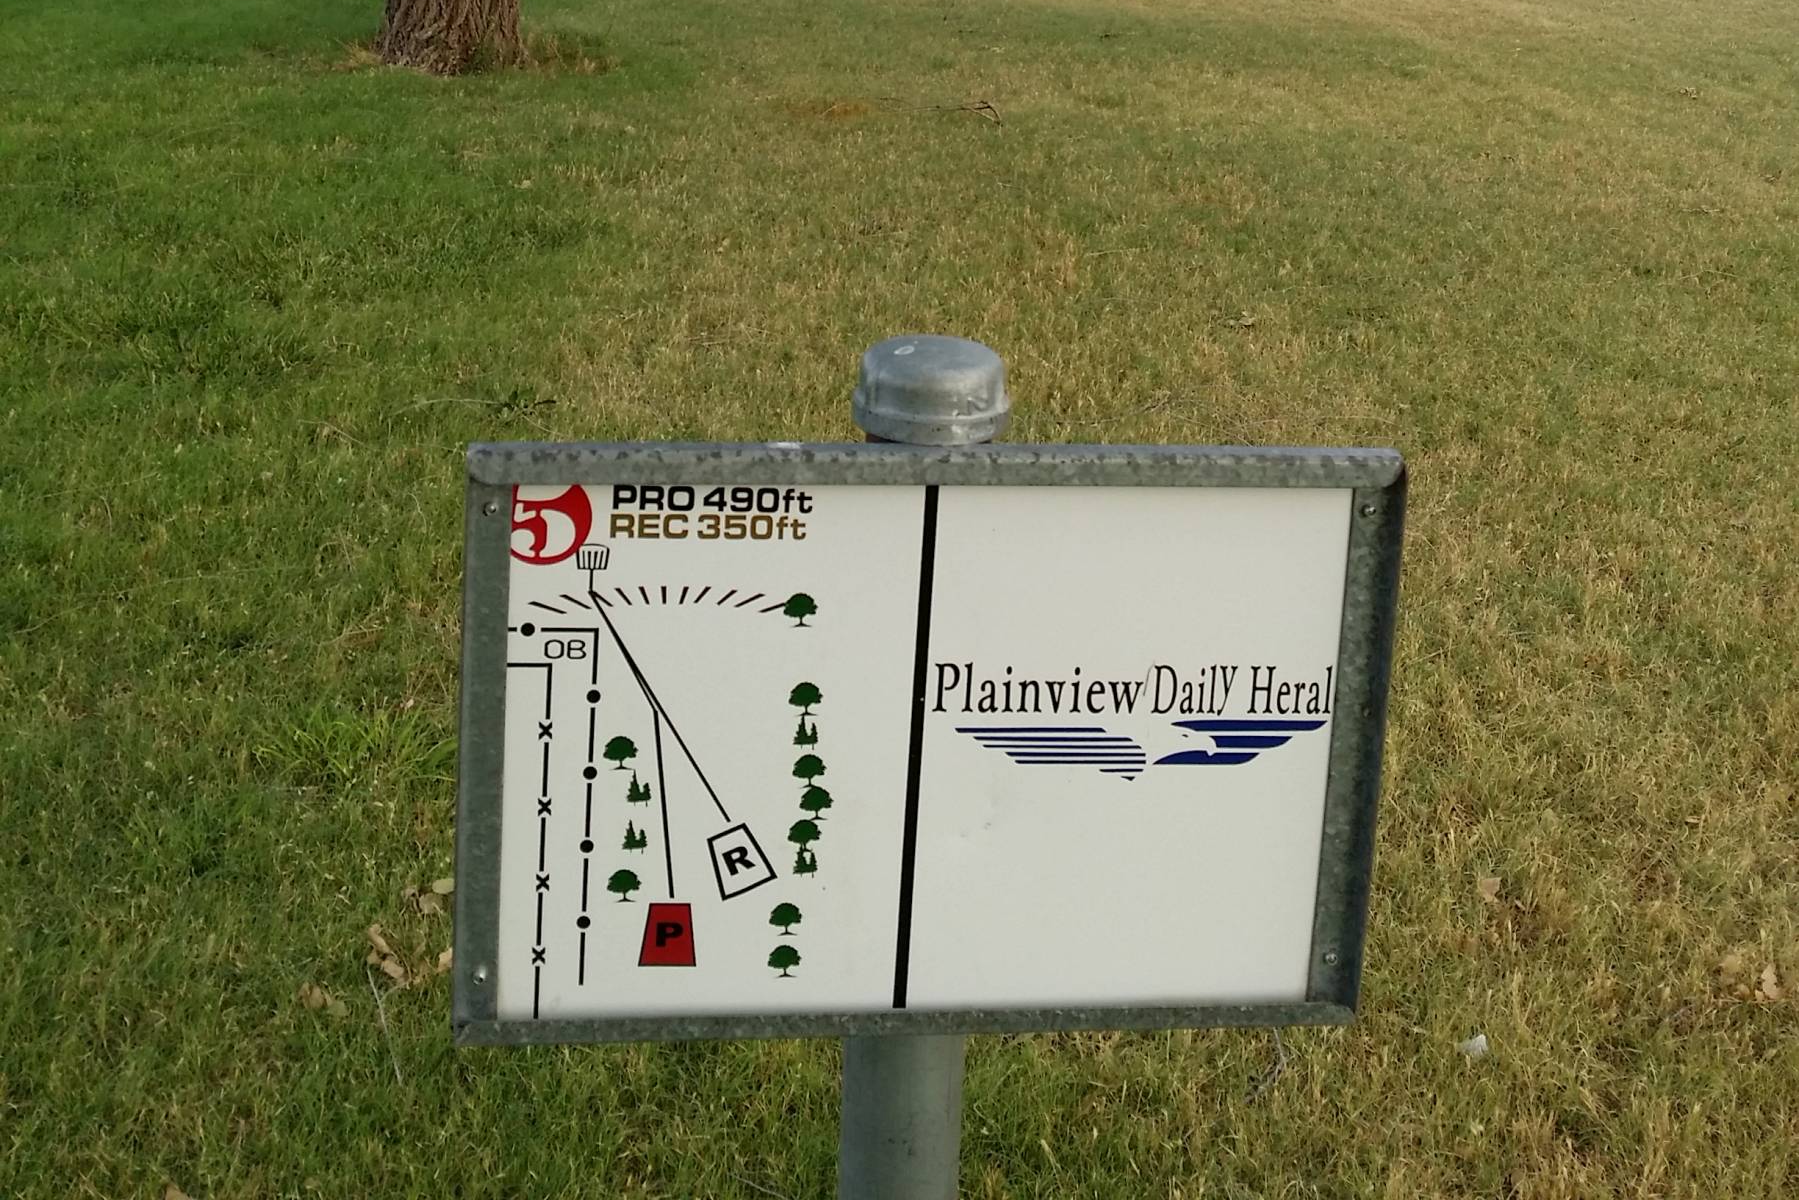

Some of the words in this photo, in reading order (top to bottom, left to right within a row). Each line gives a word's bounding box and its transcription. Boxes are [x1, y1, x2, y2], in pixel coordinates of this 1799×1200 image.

[612, 485, 696, 512] PRO
[703, 487, 813, 514] 490ft
[511, 484, 578, 558] 5
[609, 513, 690, 540] REC
[697, 514, 807, 541] 350ft
[543, 639, 587, 660] OB
[932, 662, 1144, 714] Plainview
[1151, 664, 1239, 716] Daily
[1247, 665, 1333, 715] Heral
[721, 846, 756, 876] R
[655, 922, 684, 948] P
